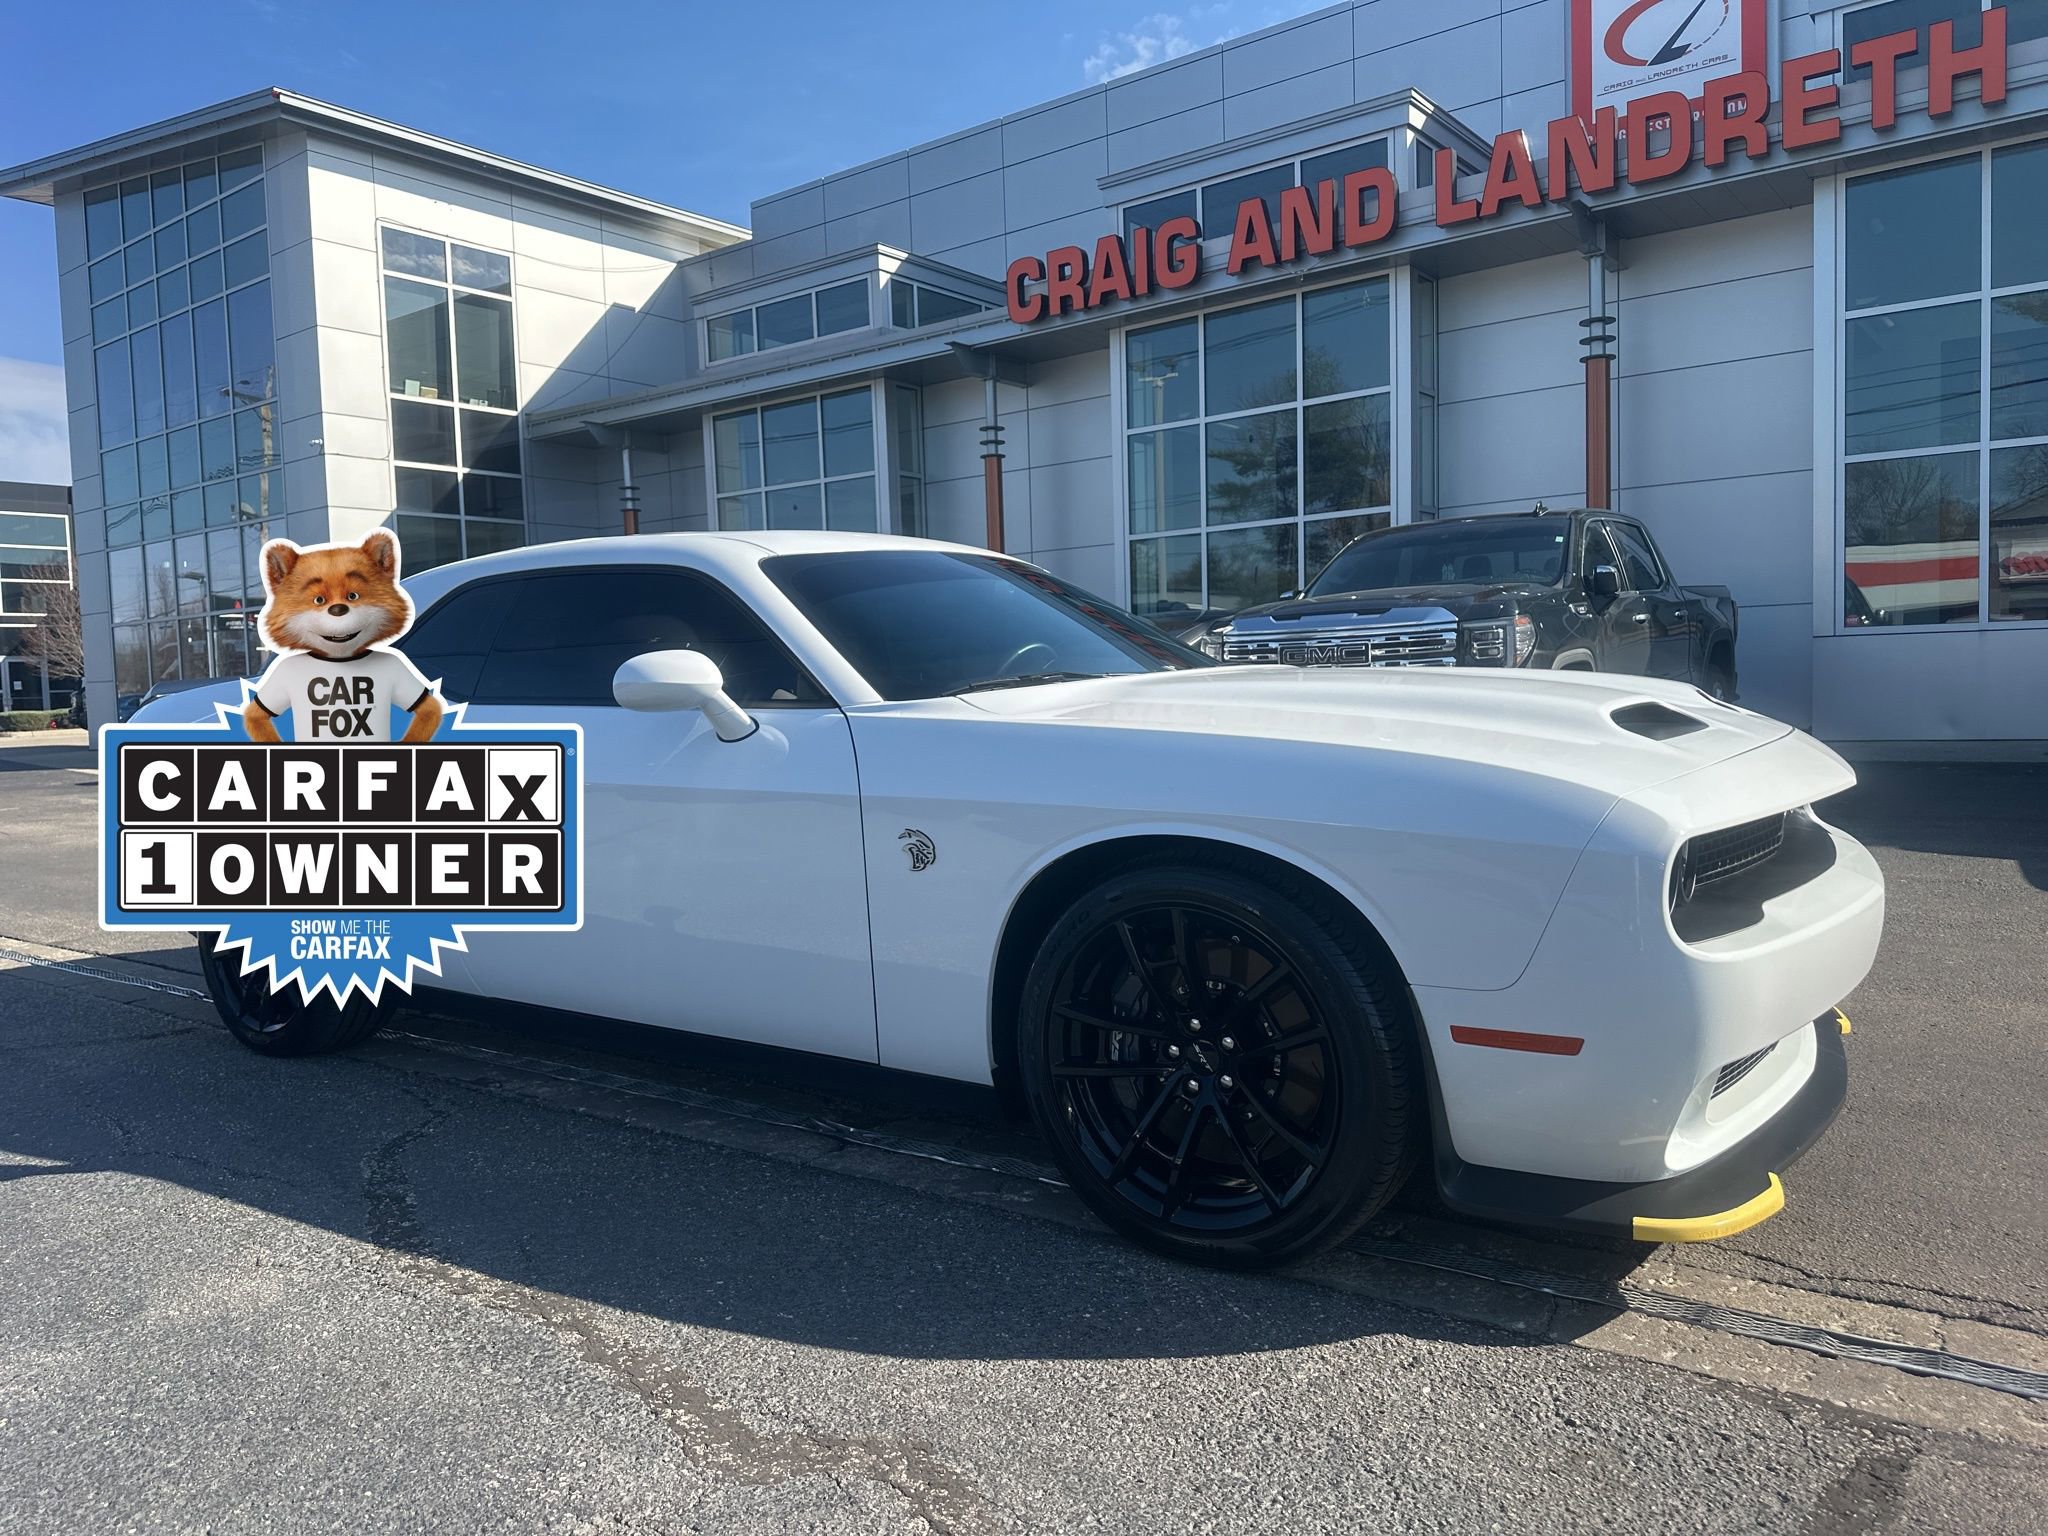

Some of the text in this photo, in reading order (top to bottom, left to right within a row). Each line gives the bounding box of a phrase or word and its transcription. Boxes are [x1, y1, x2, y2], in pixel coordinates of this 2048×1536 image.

[1647, 61, 1699, 80] LANDRETH
[1701, 53, 1729, 66] CARS
[1006, 216, 1203, 325] CRAIG
[1226, 166, 1399, 276] AND
[1434, 6, 2008, 228] LANDRETH
[1283, 645, 1366, 664] GMC
[1192, 1042, 1214, 1073] SRT
